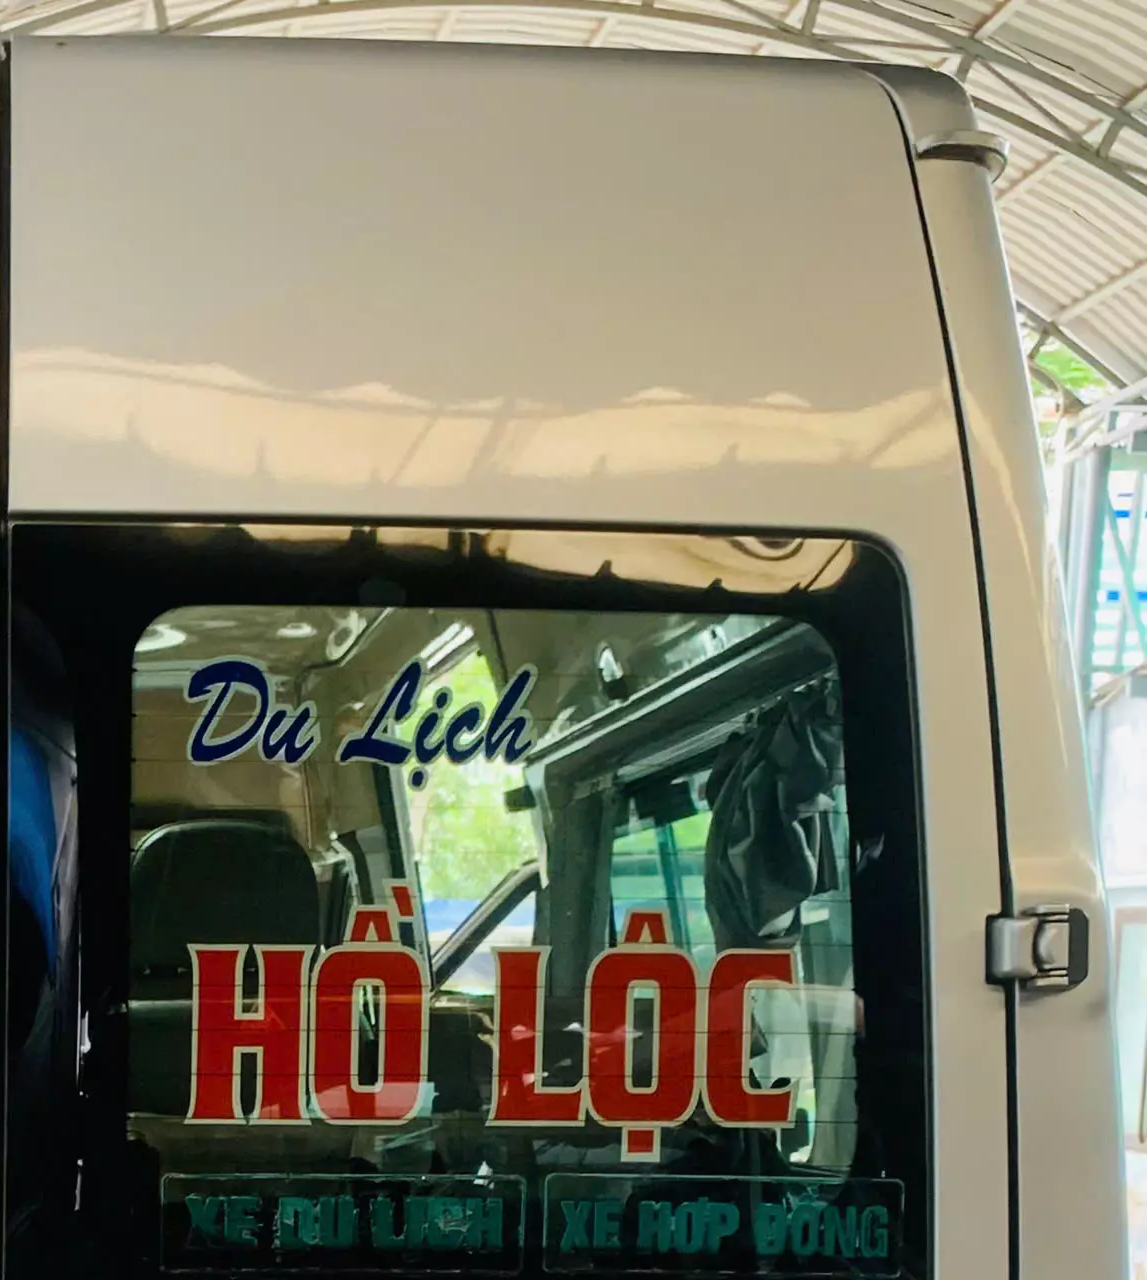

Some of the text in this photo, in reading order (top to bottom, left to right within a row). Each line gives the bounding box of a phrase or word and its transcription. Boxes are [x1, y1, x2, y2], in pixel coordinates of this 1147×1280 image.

[186, 658, 538, 791] Du Lịch
[183, 879, 797, 1161] HỒ LỘC
[560, 1199, 622, 1250] XE
